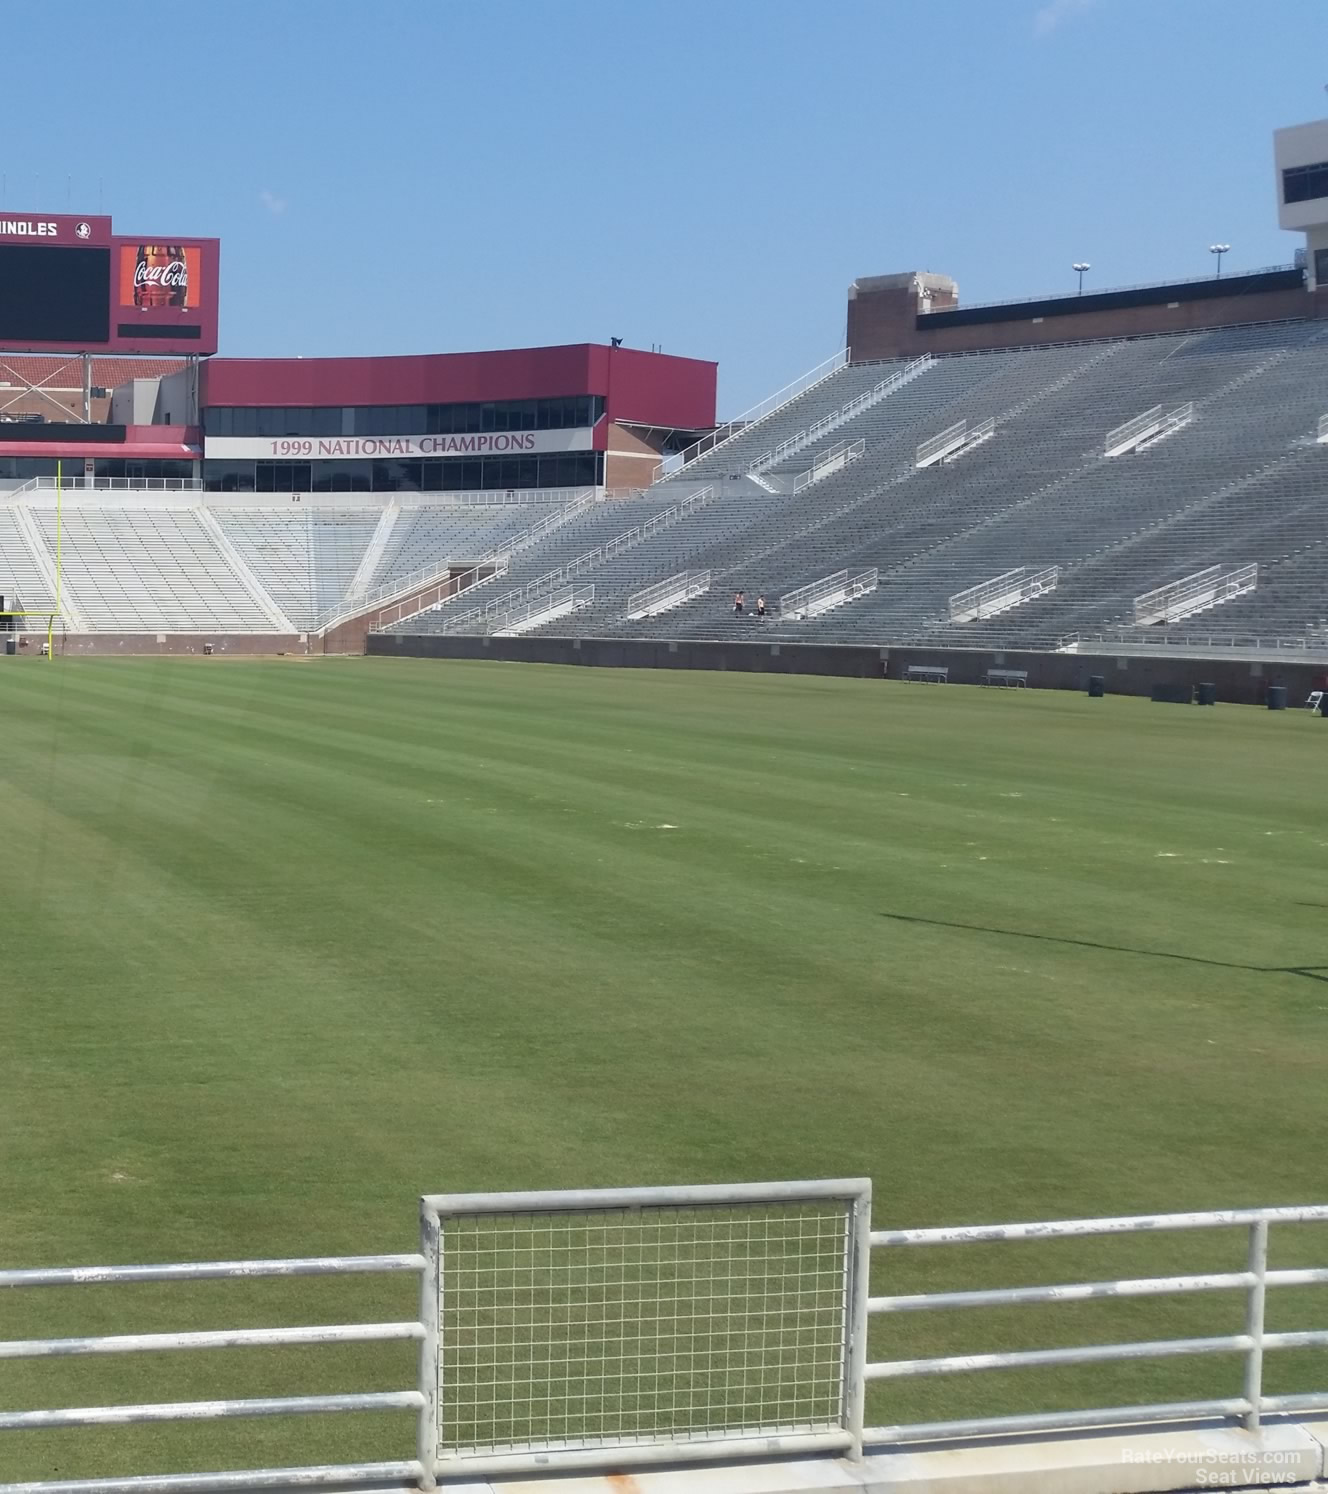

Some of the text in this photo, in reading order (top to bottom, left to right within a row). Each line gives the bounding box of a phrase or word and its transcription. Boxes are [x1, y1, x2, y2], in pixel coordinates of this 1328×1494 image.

[134, 261, 188, 287] Coca-Cola
[270, 433, 535, 456] 1999 NATIONAL CHAMPIONS
